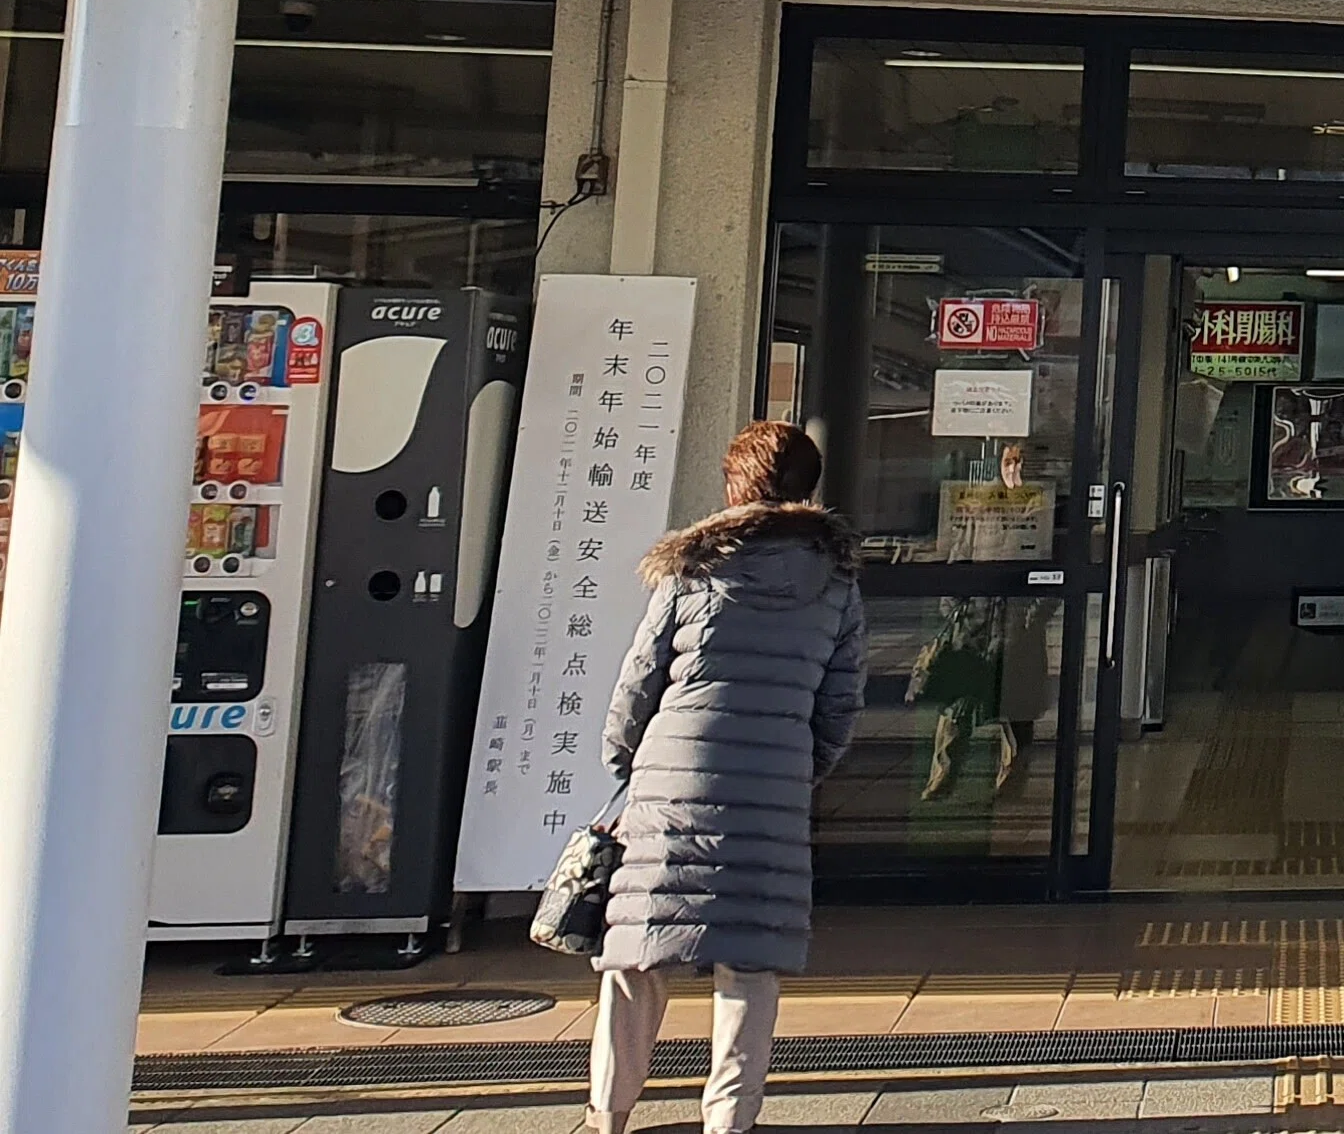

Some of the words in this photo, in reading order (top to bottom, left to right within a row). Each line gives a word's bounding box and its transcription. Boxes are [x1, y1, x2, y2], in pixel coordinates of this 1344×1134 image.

[371, 305, 442, 320] acure
[986, 326, 997, 342] NO
[629, 341, 671, 491] 二〇二一年度
[543, 318, 635, 835] 年末年始輸送安全総点検実施中
[170, 702, 248, 730] ure
[483, 715, 508, 795] 韮崎駅長
